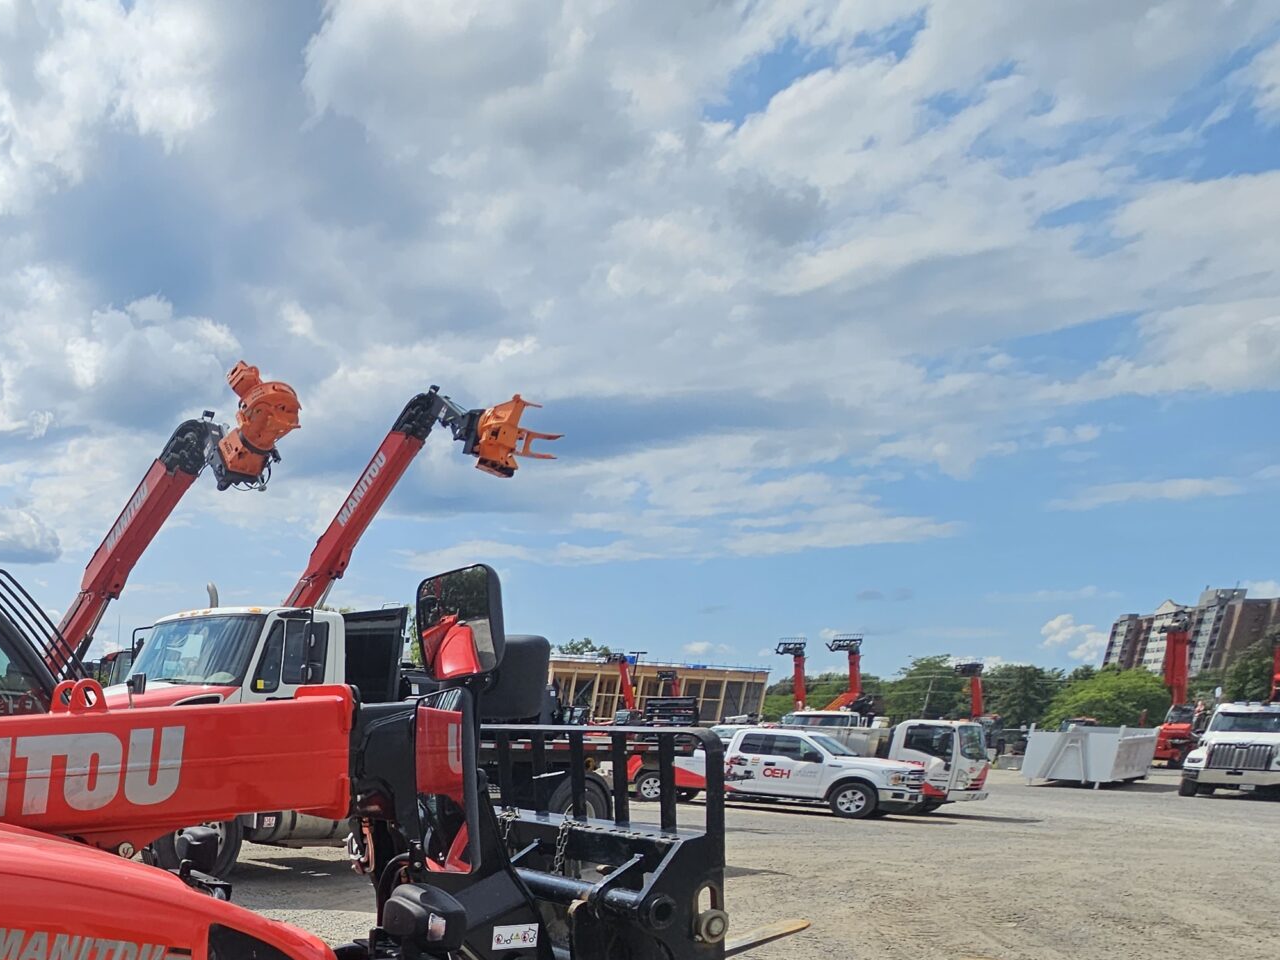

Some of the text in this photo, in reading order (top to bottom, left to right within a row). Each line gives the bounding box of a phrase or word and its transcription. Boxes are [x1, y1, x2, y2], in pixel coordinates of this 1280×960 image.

[106, 482, 150, 553] MANITOU
[337, 450, 387, 527] MANITOU
[762, 767, 792, 779] OEH
